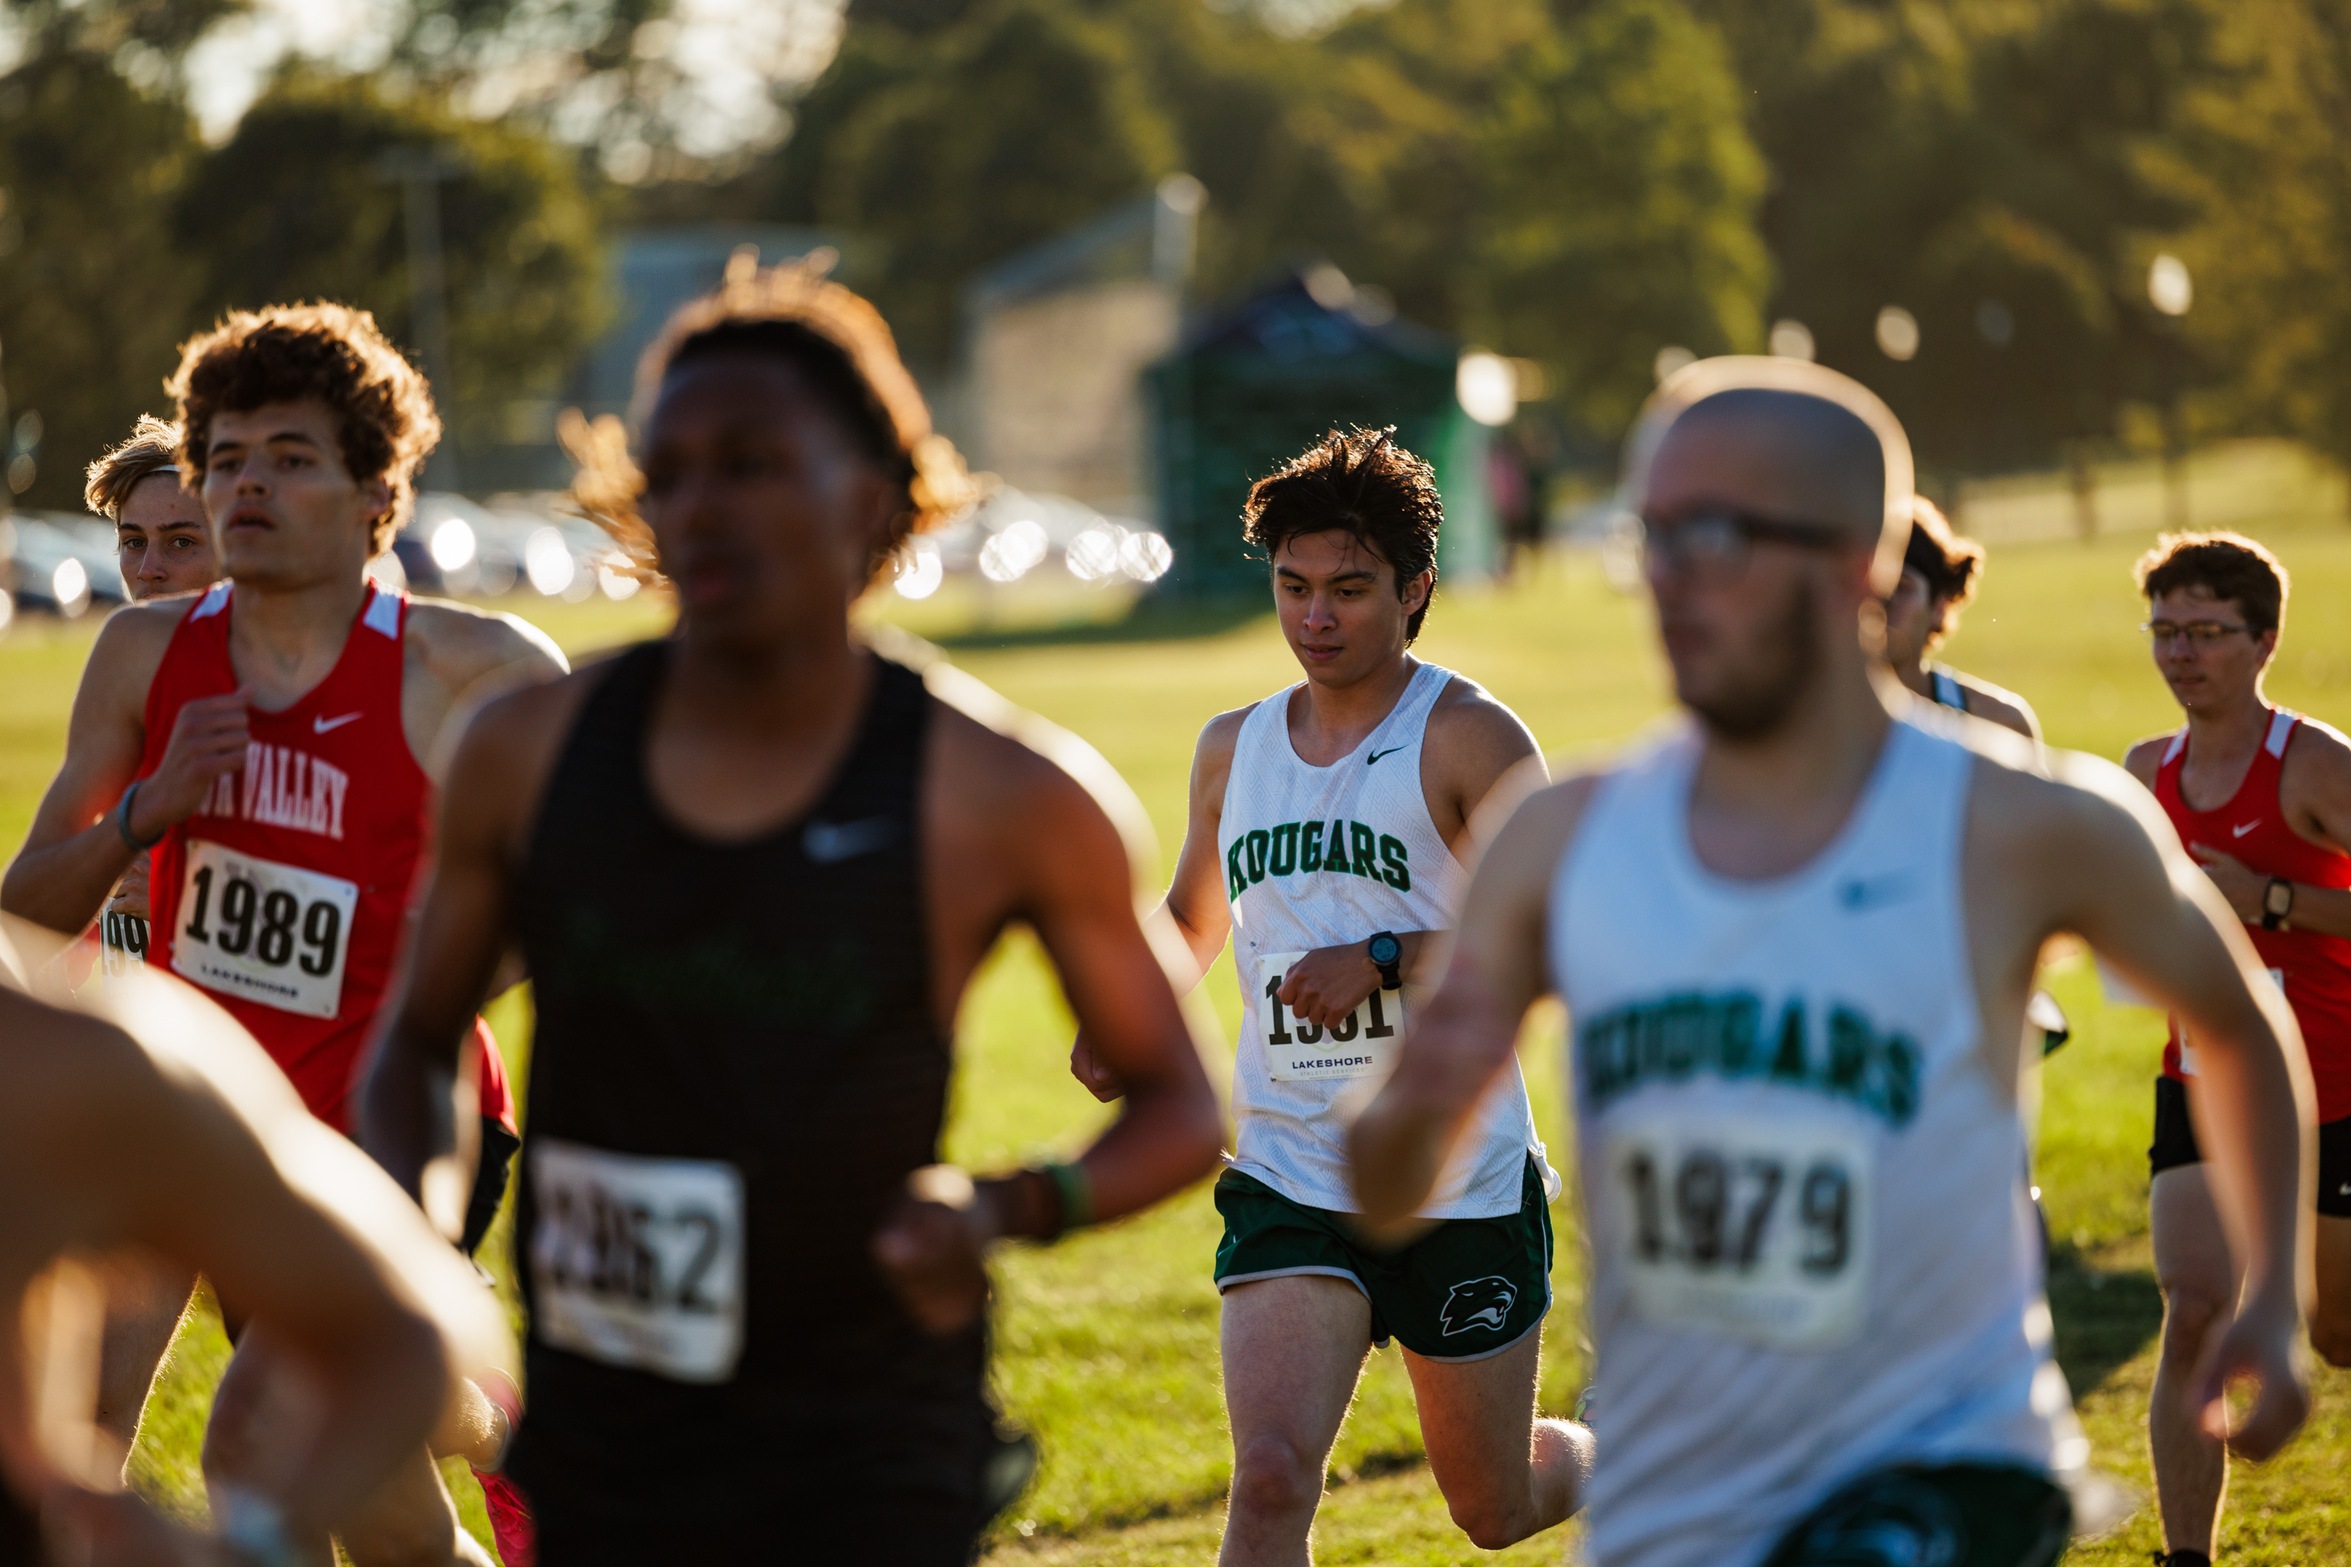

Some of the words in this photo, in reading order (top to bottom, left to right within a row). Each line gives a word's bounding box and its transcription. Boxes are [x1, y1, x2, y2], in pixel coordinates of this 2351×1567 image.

[242, 740, 348, 840] VALLEY
[1229, 819, 1411, 903] KOUGARS
[186, 865, 341, 978] 1989
[1292, 1056, 1373, 1069] LAKESHORE
[1622, 1147, 1852, 1278] 1979
